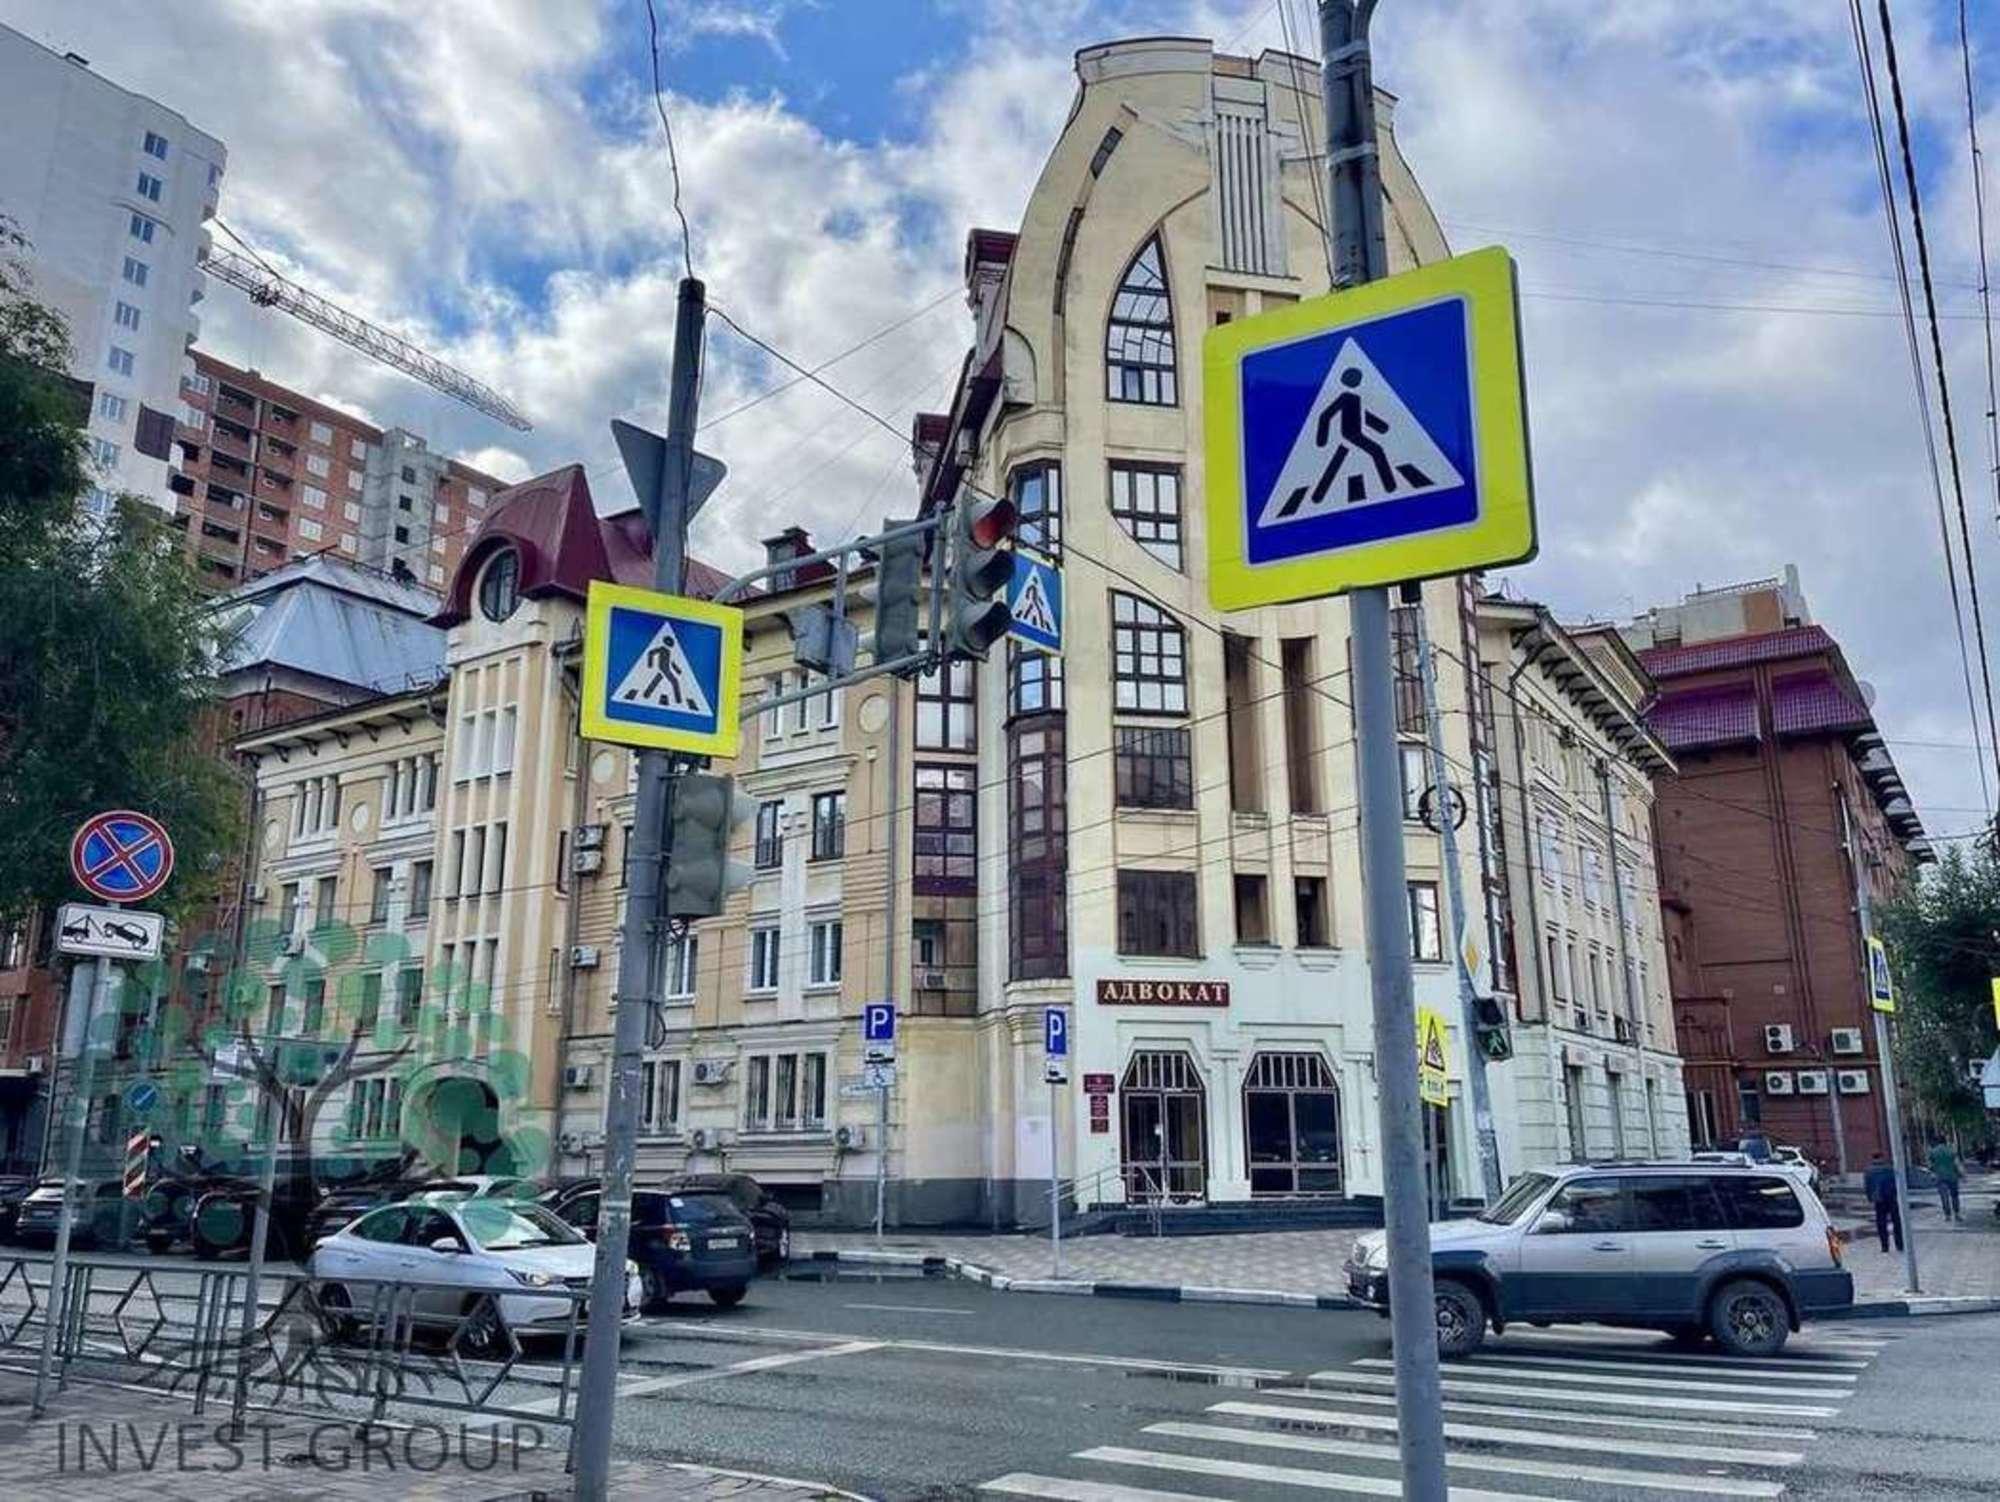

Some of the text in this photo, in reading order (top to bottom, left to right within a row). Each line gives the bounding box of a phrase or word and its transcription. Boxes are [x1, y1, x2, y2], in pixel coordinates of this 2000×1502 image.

[1103, 982, 1227, 1002] АДВОКАТ
[871, 1008, 889, 1037] P
[1049, 1014, 1062, 1050] P
